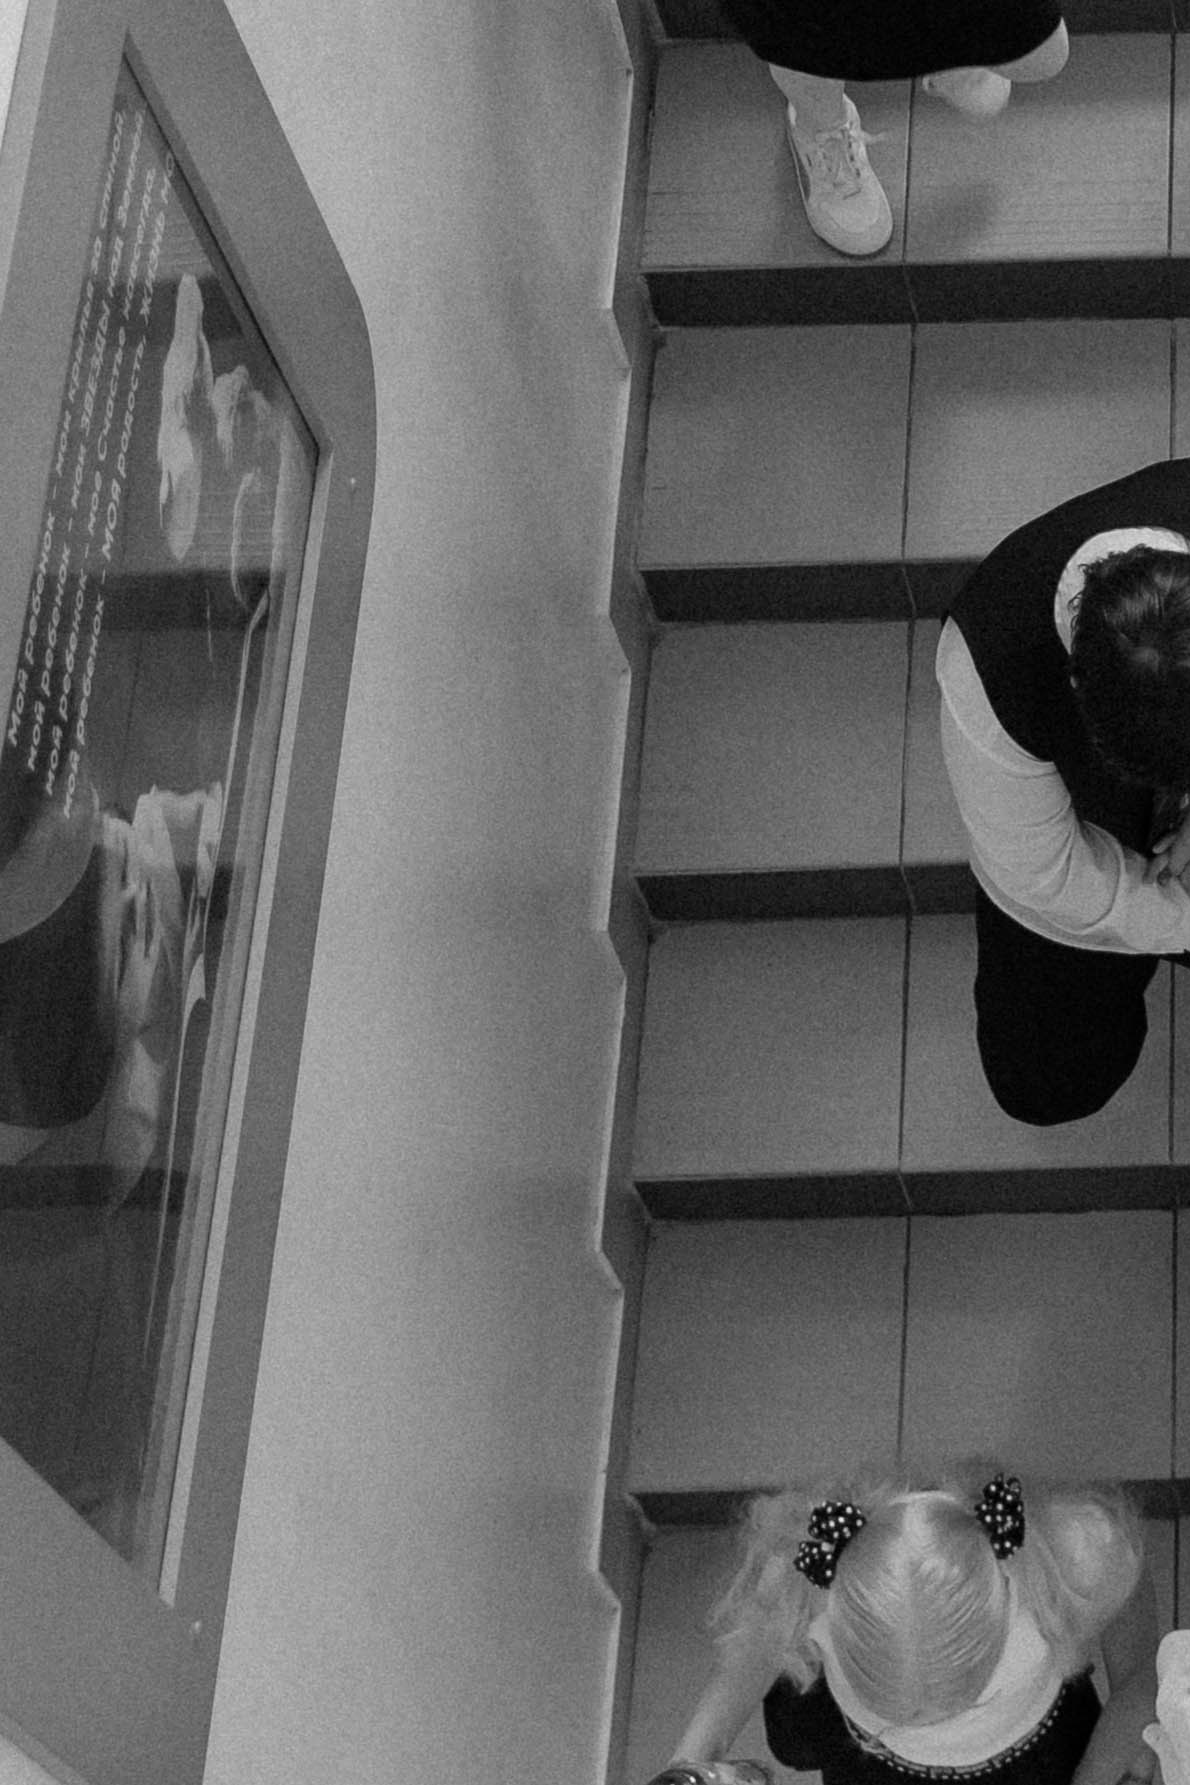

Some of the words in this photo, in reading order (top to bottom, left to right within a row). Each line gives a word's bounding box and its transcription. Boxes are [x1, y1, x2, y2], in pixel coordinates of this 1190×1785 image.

[7, 668, 28, 748] Мой
[25, 511, 56, 666] ребенок
[56, 409, 72, 477] мои
[68, 278, 94, 404] крылья
[90, 235, 102, 276] за
[28, 700, 46, 772] мой
[40, 542, 71, 698] ребенок
[71, 441, 87, 509] мои
[81, 298, 111, 437] ЗВЕЗДЫ
[107, 235, 124, 298] над
[46, 724, 63, 796] мой
[59, 566, 88, 723] ребенок
[87, 470, 102, 537] мое
[97, 326, 126, 462] Счастье
[63, 748, 81, 819] мой
[76, 593, 105, 747] ребенок
[101, 478, 121, 562] МОЯ
[160, 150, 175, 205] МО
